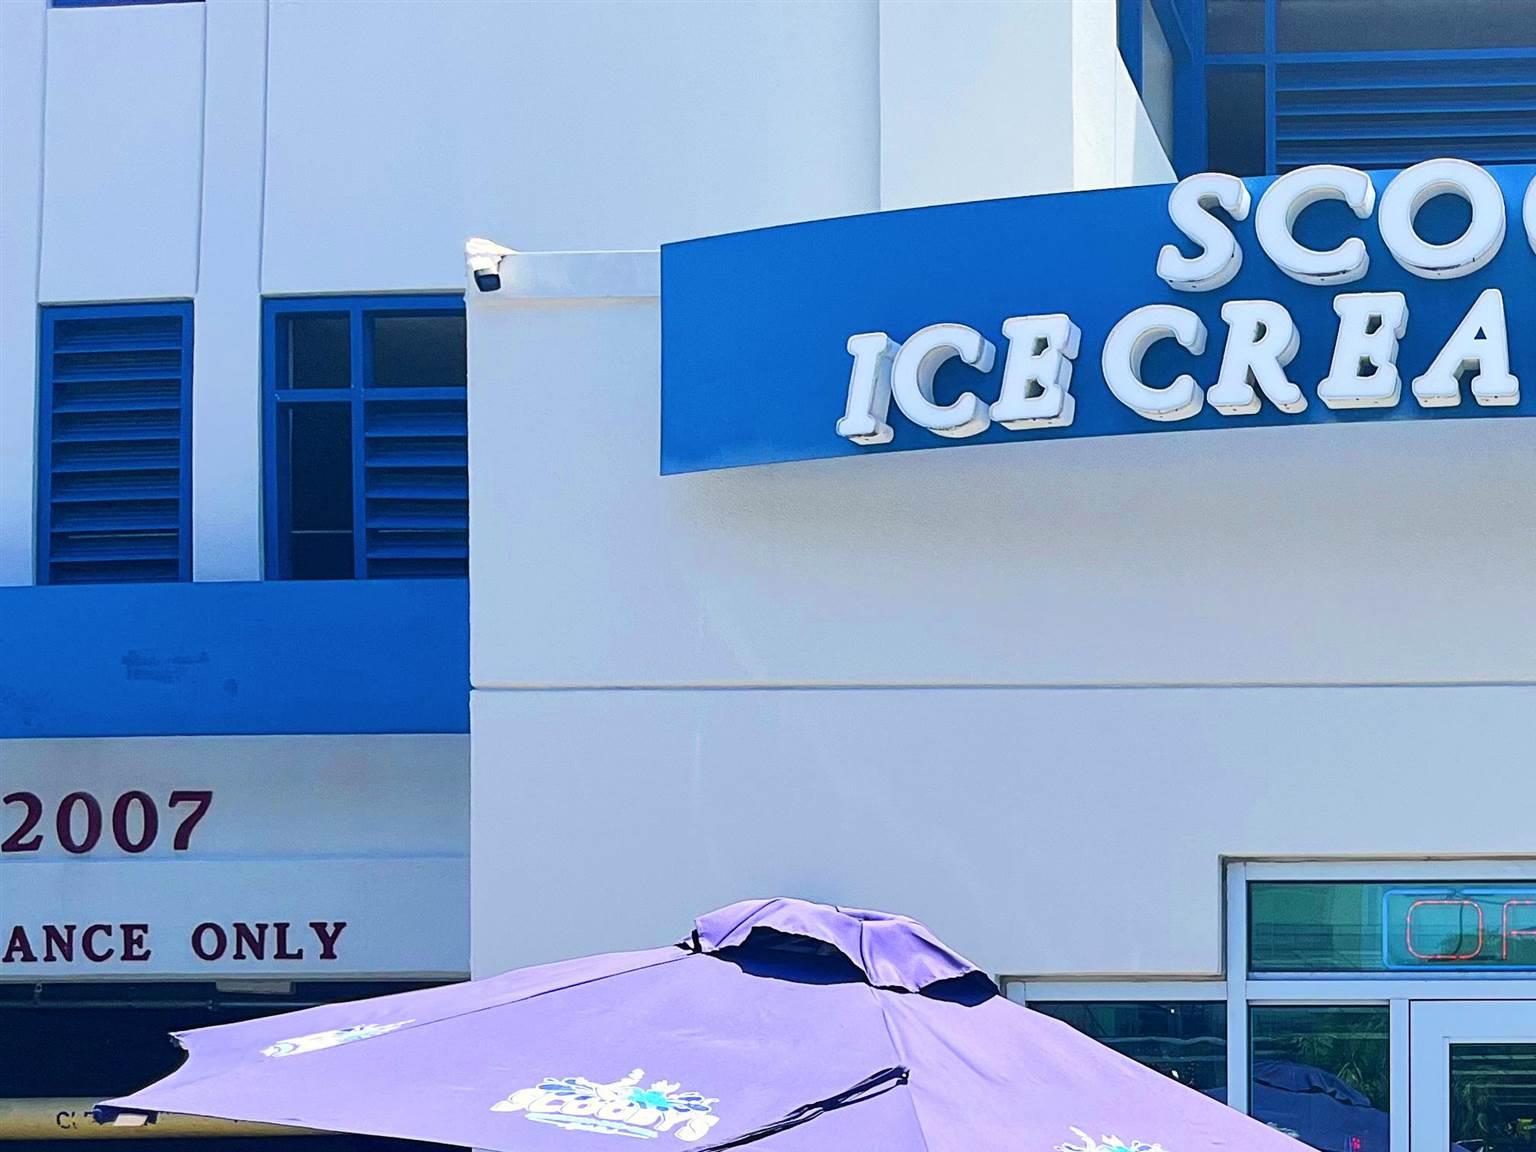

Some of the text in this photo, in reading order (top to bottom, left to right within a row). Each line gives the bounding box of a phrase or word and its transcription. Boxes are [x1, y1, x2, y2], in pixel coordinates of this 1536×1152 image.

[835, 314, 1080, 445] ICE
[0, 790, 213, 854] 2007
[2, 921, 347, 962] ANCE ONLY
